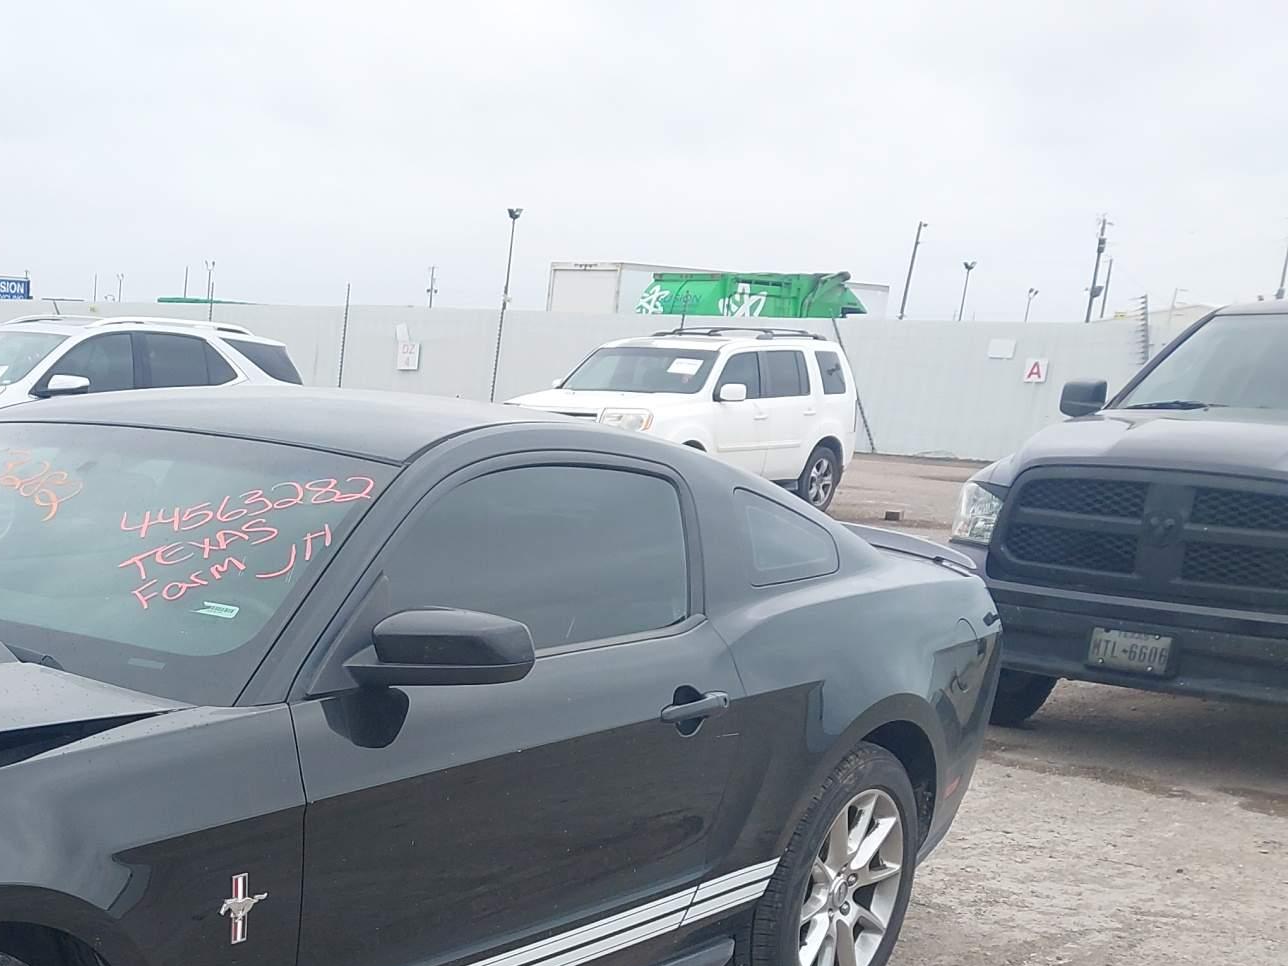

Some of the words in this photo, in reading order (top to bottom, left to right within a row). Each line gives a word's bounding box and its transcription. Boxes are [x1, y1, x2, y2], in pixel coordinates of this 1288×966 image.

[1026, 360, 1042, 379] A
[119, 476, 375, 538] 44563282
[118, 518, 279, 579] TEXAS
